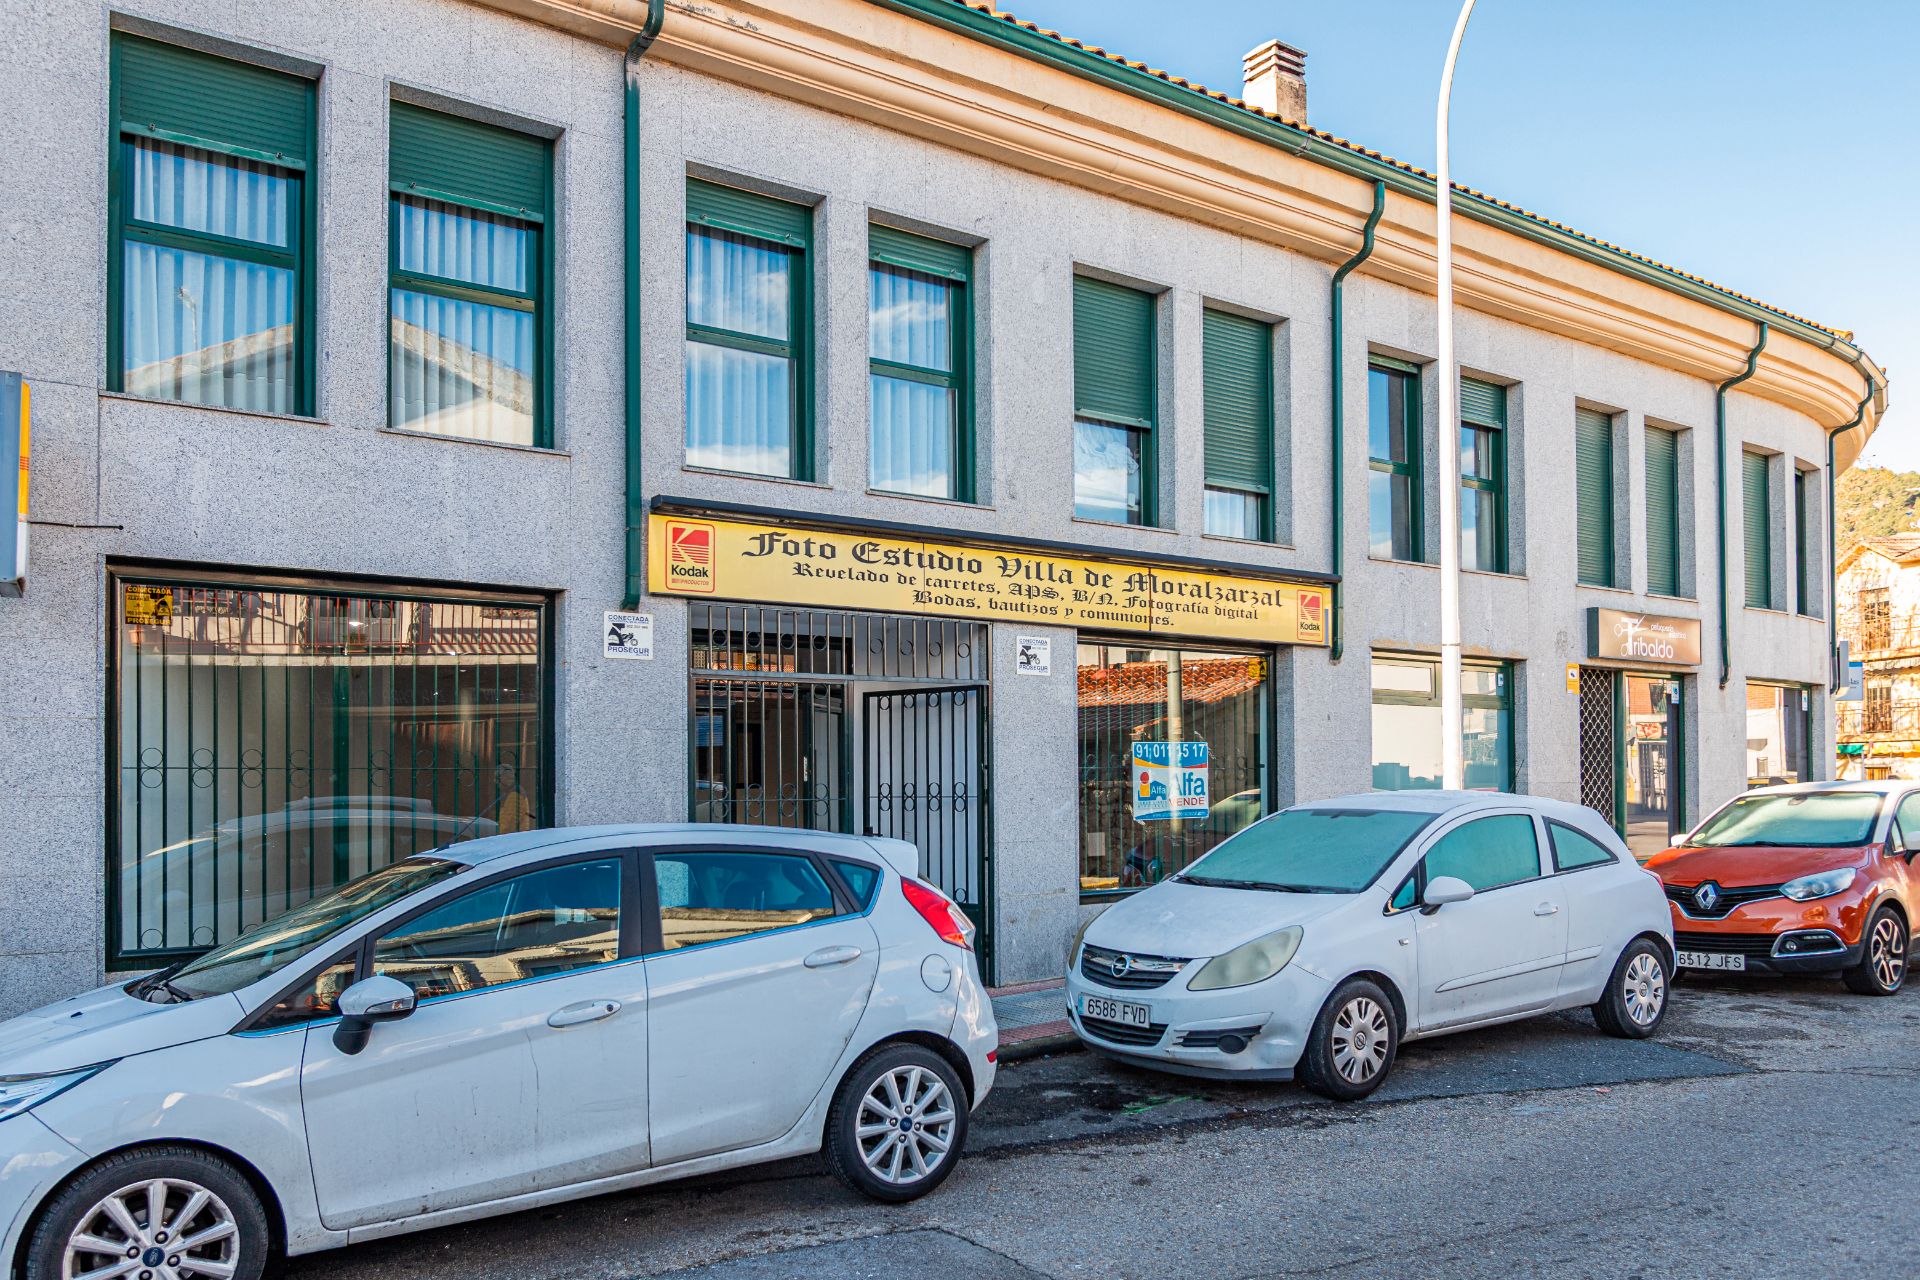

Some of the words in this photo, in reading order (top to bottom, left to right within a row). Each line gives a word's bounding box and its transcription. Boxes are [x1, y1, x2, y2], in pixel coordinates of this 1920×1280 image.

[671, 564, 709, 578] Kodak
[741, 531, 836, 560] Foto
[851, 541, 982, 574] Estudio
[994, 555, 1074, 585] Villa
[1084, 567, 1113, 588] de
[1121, 572, 1284, 608] Moralzarzal
[127, 586, 171, 595] CONECTADA
[792, 561, 889, 583] Revelado
[896, 571, 917, 586] de
[925, 577, 1001, 595] carretes,
[1008, 582, 1064, 602] APS,
[1121, 595, 1209, 615] Fotografía
[1213, 604, 1259, 620] digital
[912, 589, 981, 610] Bodas,
[988, 598, 1058, 617] bautizos
[1063, 607, 1074, 619] y
[1080, 609, 1175, 626] comuniones.
[608, 614, 649, 622] CONECTADA
[1300, 621, 1321, 631] Kodak
[1621, 616, 1674, 659] Tribaldo
[607, 646, 650, 655] PROSEGUR
[1136, 743, 1149, 758] 91
[1192, 743, 1205, 758] 17
[1151, 785, 1166, 795] Alfa
[1168, 771, 1206, 796] Alfa
[1679, 953, 1711, 967] 6512
[1715, 955, 1742, 969] JFS
[1087, 998, 1117, 1019] 6586
[1122, 1004, 1147, 1024] FVD
